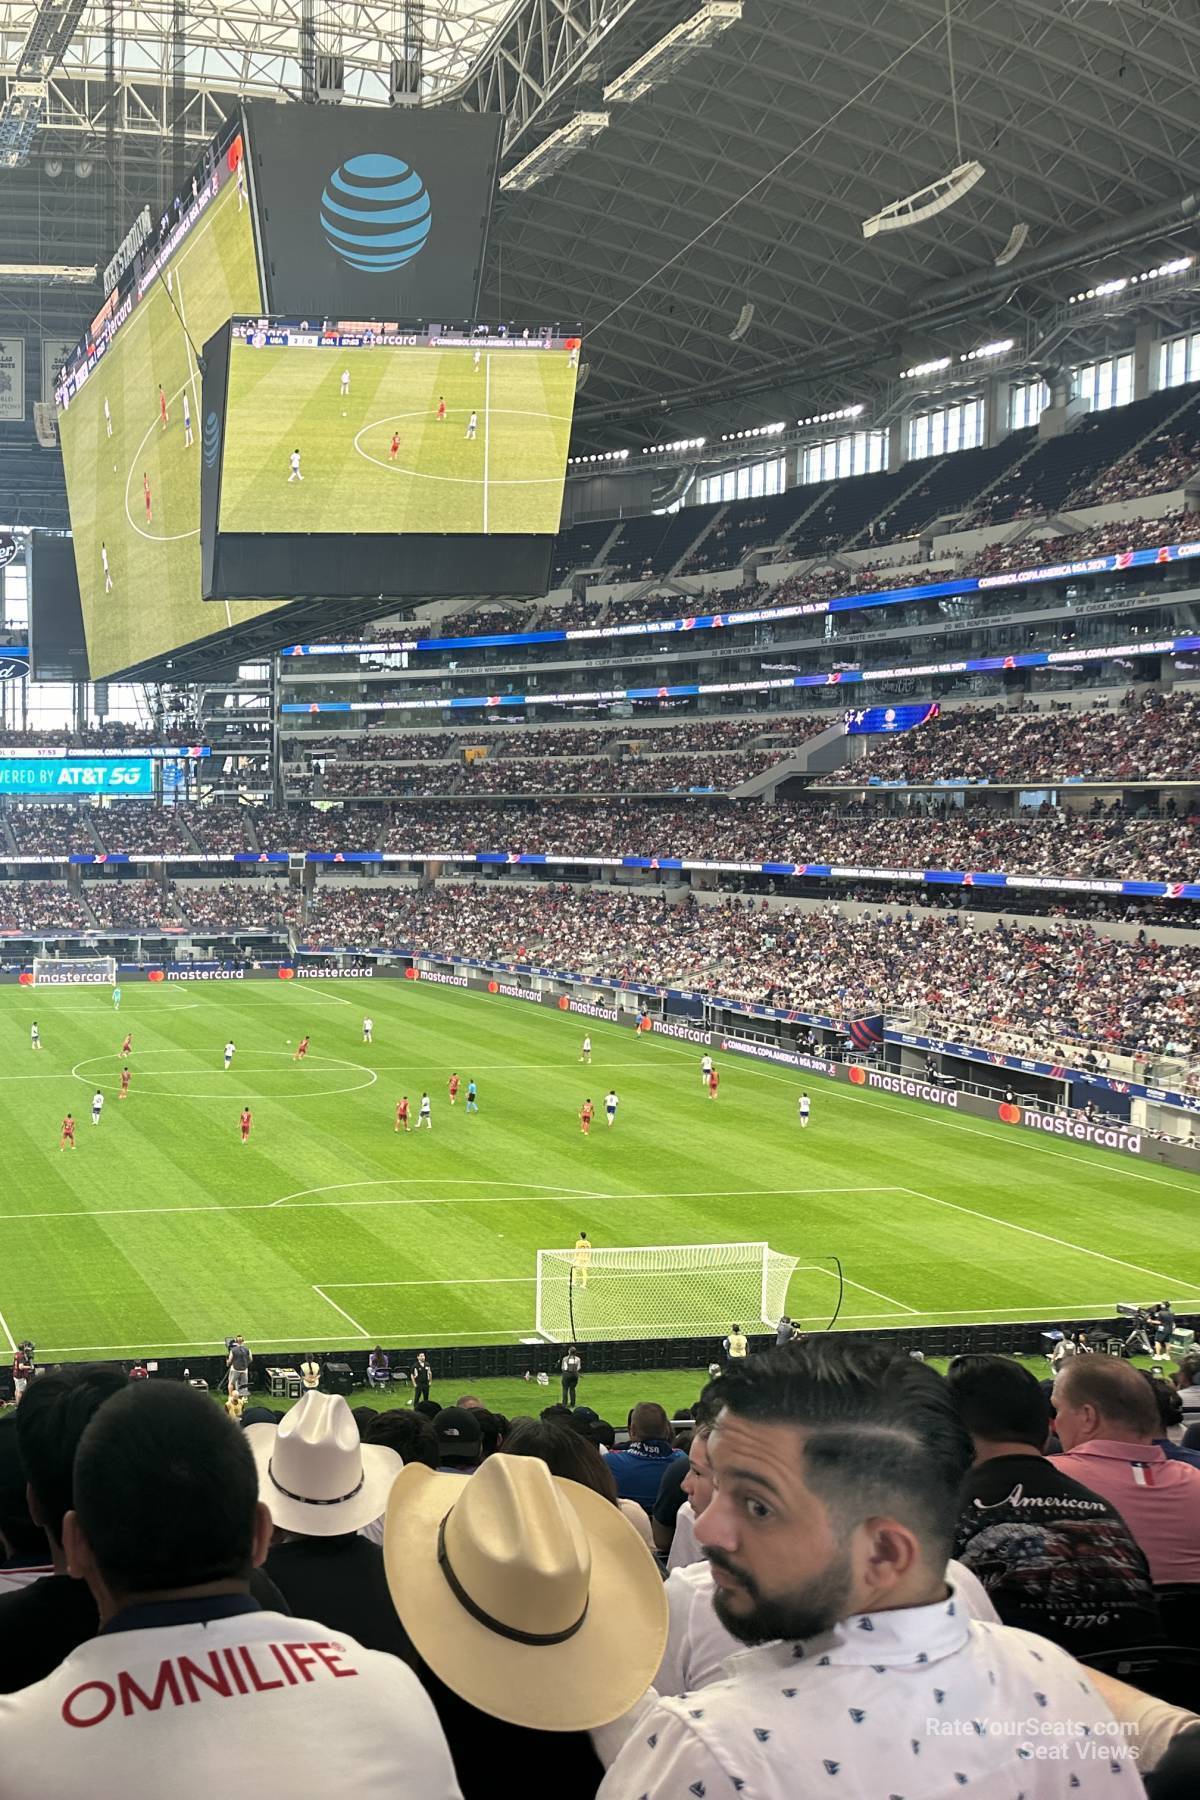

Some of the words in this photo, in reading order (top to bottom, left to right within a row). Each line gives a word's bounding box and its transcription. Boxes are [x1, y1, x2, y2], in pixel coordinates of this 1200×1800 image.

[978, 573, 1017, 588] CONMEBOL
[1018, 570, 1040, 582] COPA
[1039, 565, 1071, 579] AMERICA
[1072, 563, 1087, 574] USA
[1088, 560, 1107, 571] 2024
[728, 611, 760, 623] CONMEBOL
[761, 609, 777, 619] COPA
[776, 606, 802, 617] AMERICA
[803, 604, 814, 613] USA
[815, 602, 829, 612] 2024
[1108, 600, 1136, 609] HOWLEY
[566, 629, 602, 639] CONMEBOL
[602, 627, 619, 636] COPA
[618, 625, 646, 635] AMERICA
[647, 624, 660, 632] USA
[661, 622, 675, 631] 2024
[40, 769, 54, 784] BY
[57, 767, 107, 785] AT&T
[108, 767, 142, 785] 5G
[168, 968, 244, 980] mastercard
[297, 967, 373, 978] mastercard
[420, 970, 468, 987] mastercard
[499, 983, 542, 1003] mastercard
[570, 998, 618, 1022] mastercard
[653, 1019, 712, 1045] mastercard
[727, 1040, 758, 1054] CONMEBOL
[758, 1048, 773, 1058] COPA
[772, 1051, 799, 1064] AMERICA
[799, 1057, 811, 1068] USA
[811, 1060, 827, 1071] 2024
[869, 1071, 958, 1107] mastercard
[1025, 1110, 1141, 1154] mastercard
[973, 1483, 1106, 1511] American
[1064, 1611, 1110, 1628] 1776
[62, 1641, 358, 1728] OMNILIFE
